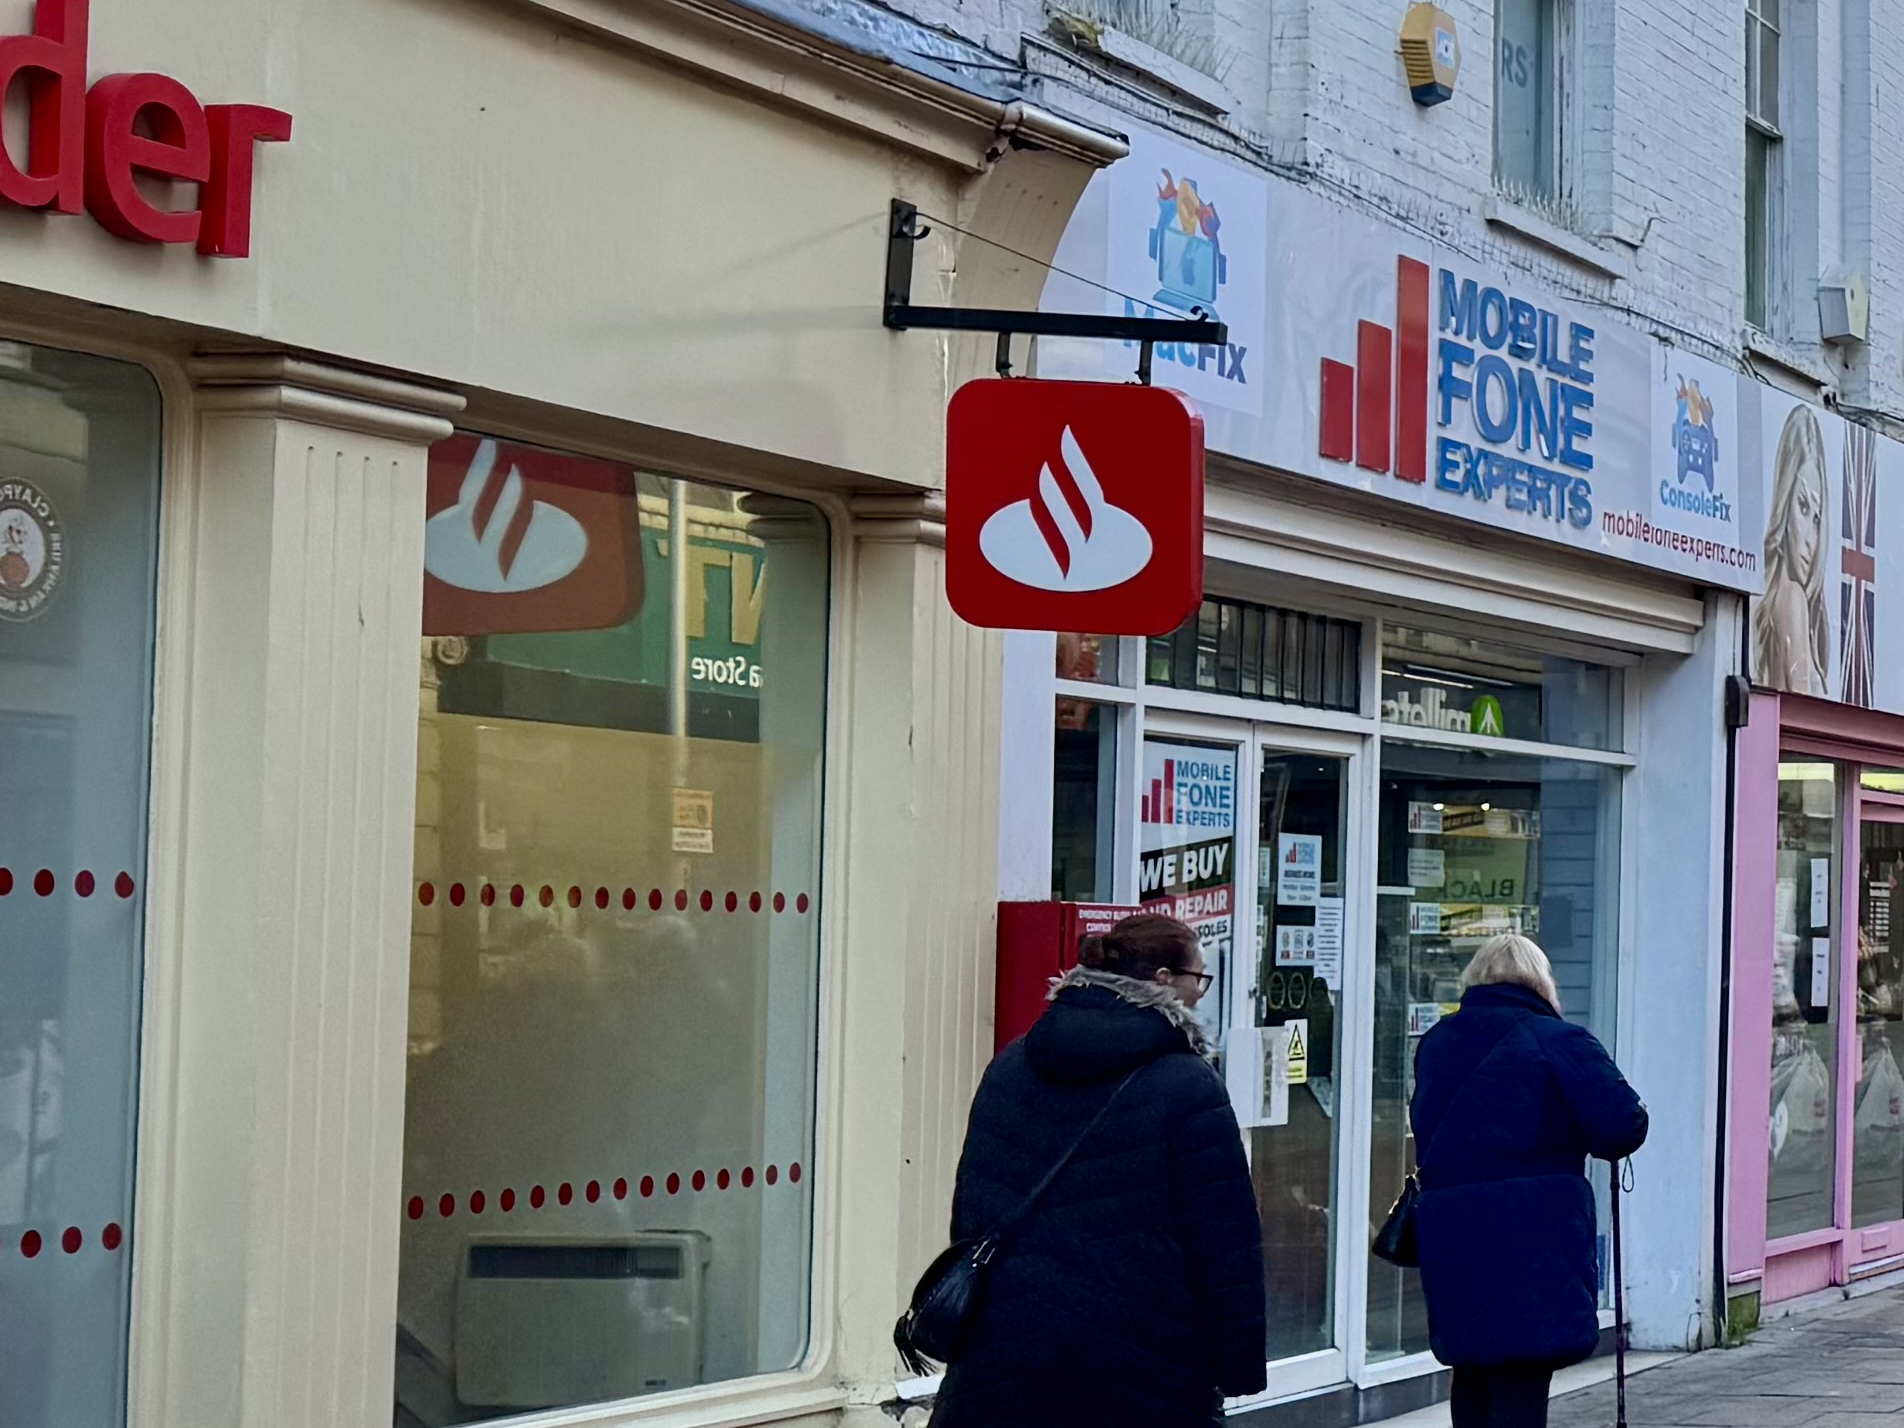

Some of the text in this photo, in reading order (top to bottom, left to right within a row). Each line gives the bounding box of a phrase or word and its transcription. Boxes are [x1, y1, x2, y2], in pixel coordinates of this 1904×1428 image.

[1438, 268, 1595, 385] MOBILE
[1438, 337, 1594, 471] FONE
[1435, 435, 1593, 530] EXPERTS
[1660, 479, 1731, 523] ConsoleFix
[1176, 760, 1231, 781] MOBILE
[1175, 782, 1231, 809] FONE
[1175, 811, 1231, 828] EXPERTS
[1140, 843, 1230, 893] WE BUY
[1175, 889, 1228, 920] REPAIR
[1198, 919, 1228, 938] SOLES
